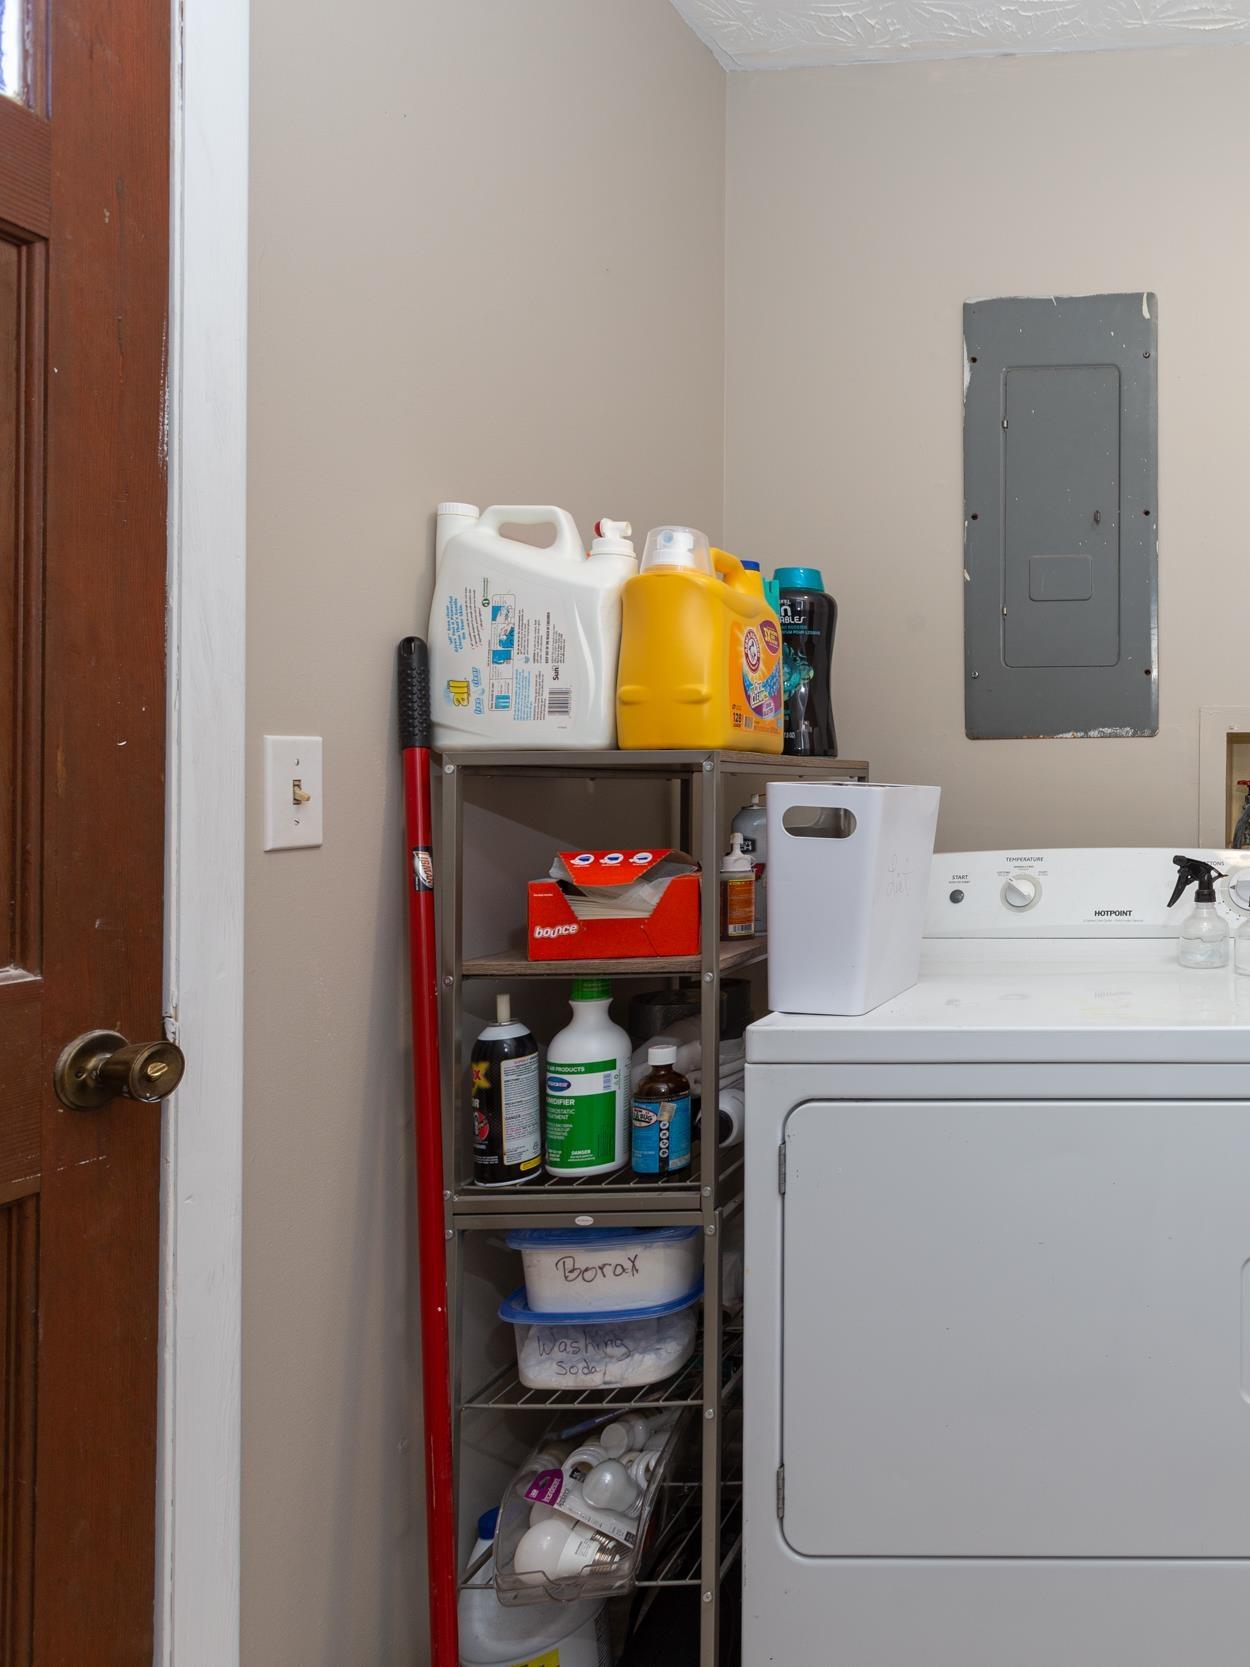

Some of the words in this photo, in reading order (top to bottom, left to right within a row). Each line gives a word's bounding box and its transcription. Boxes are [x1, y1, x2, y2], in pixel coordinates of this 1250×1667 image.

[447, 680, 470, 706] all
[1094, 909, 1133, 917] HOTPOINT
[533, 923, 579, 939] bounce
[555, 1254, 639, 1283] Borax
[537, 1330, 633, 1362] Washing
[555, 1358, 601, 1376] Soda
